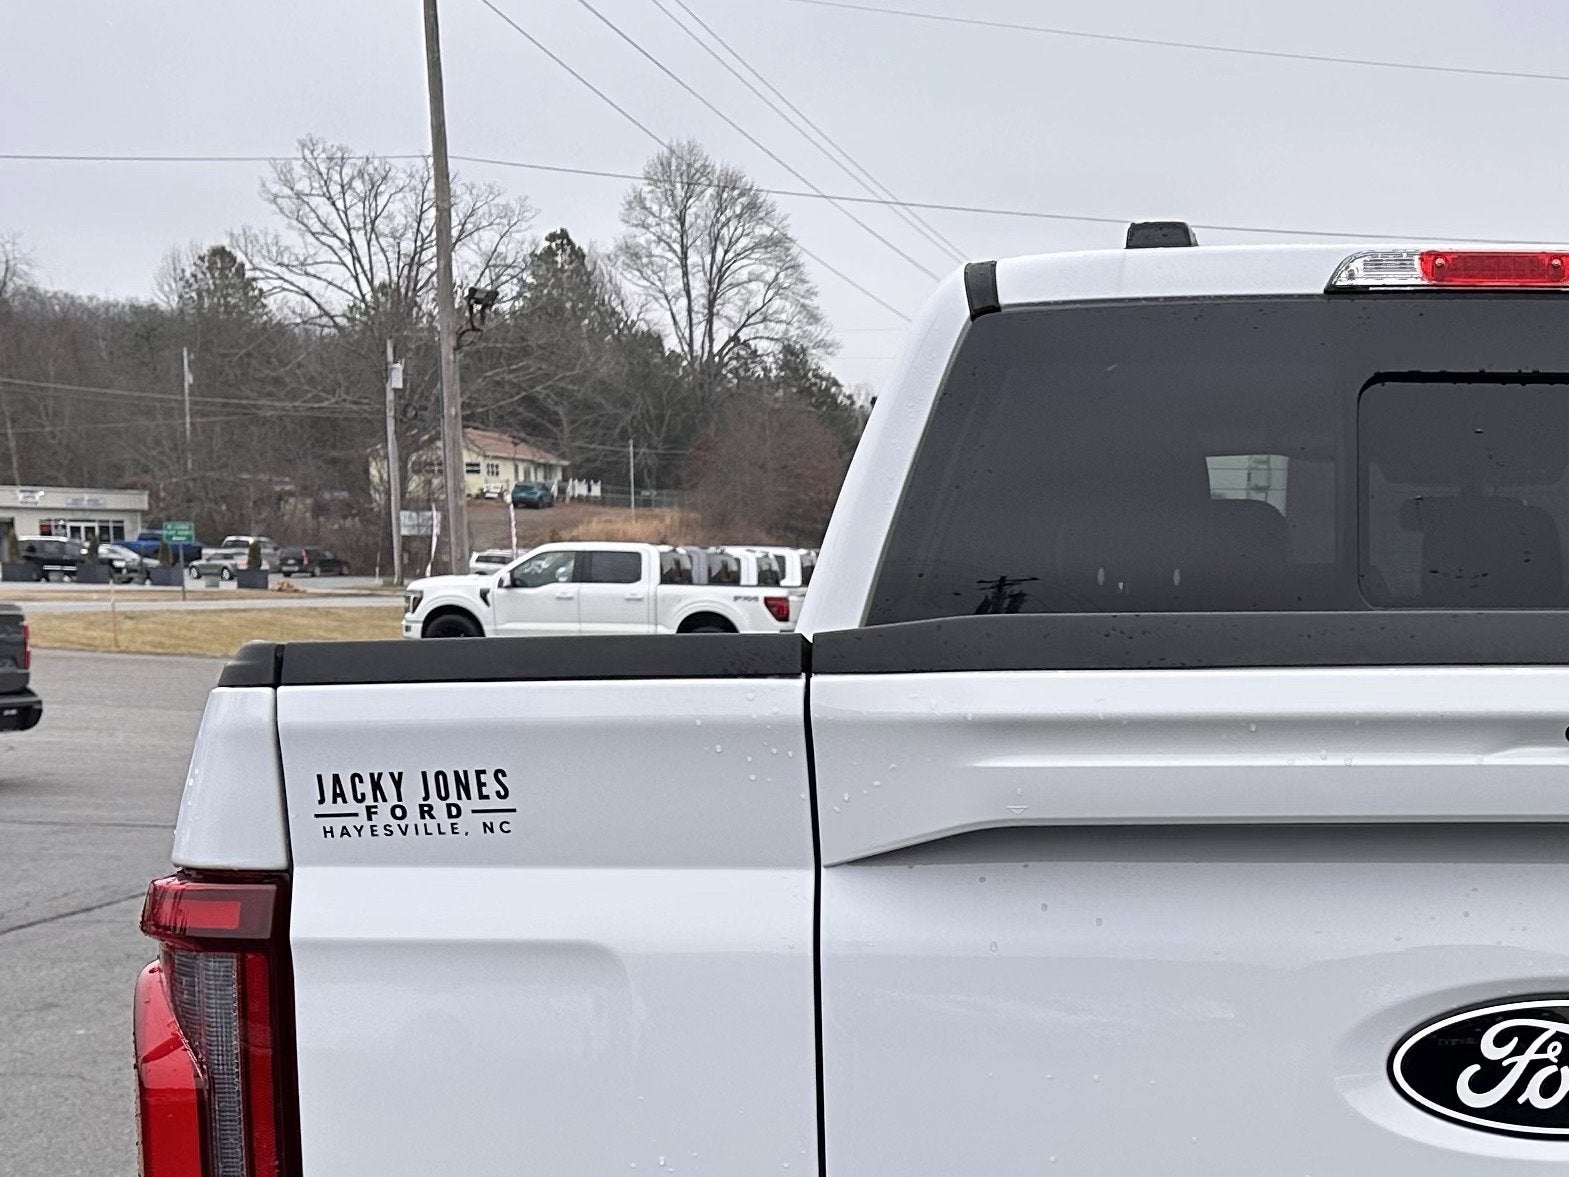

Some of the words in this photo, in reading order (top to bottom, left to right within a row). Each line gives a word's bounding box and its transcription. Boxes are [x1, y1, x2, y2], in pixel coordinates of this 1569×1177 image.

[316, 771, 404, 805] JACKY
[420, 768, 510, 802] JONES
[365, 802, 462, 822] FORD
[322, 822, 469, 839] HAYESVILLE,
[482, 821, 511, 835] NC
